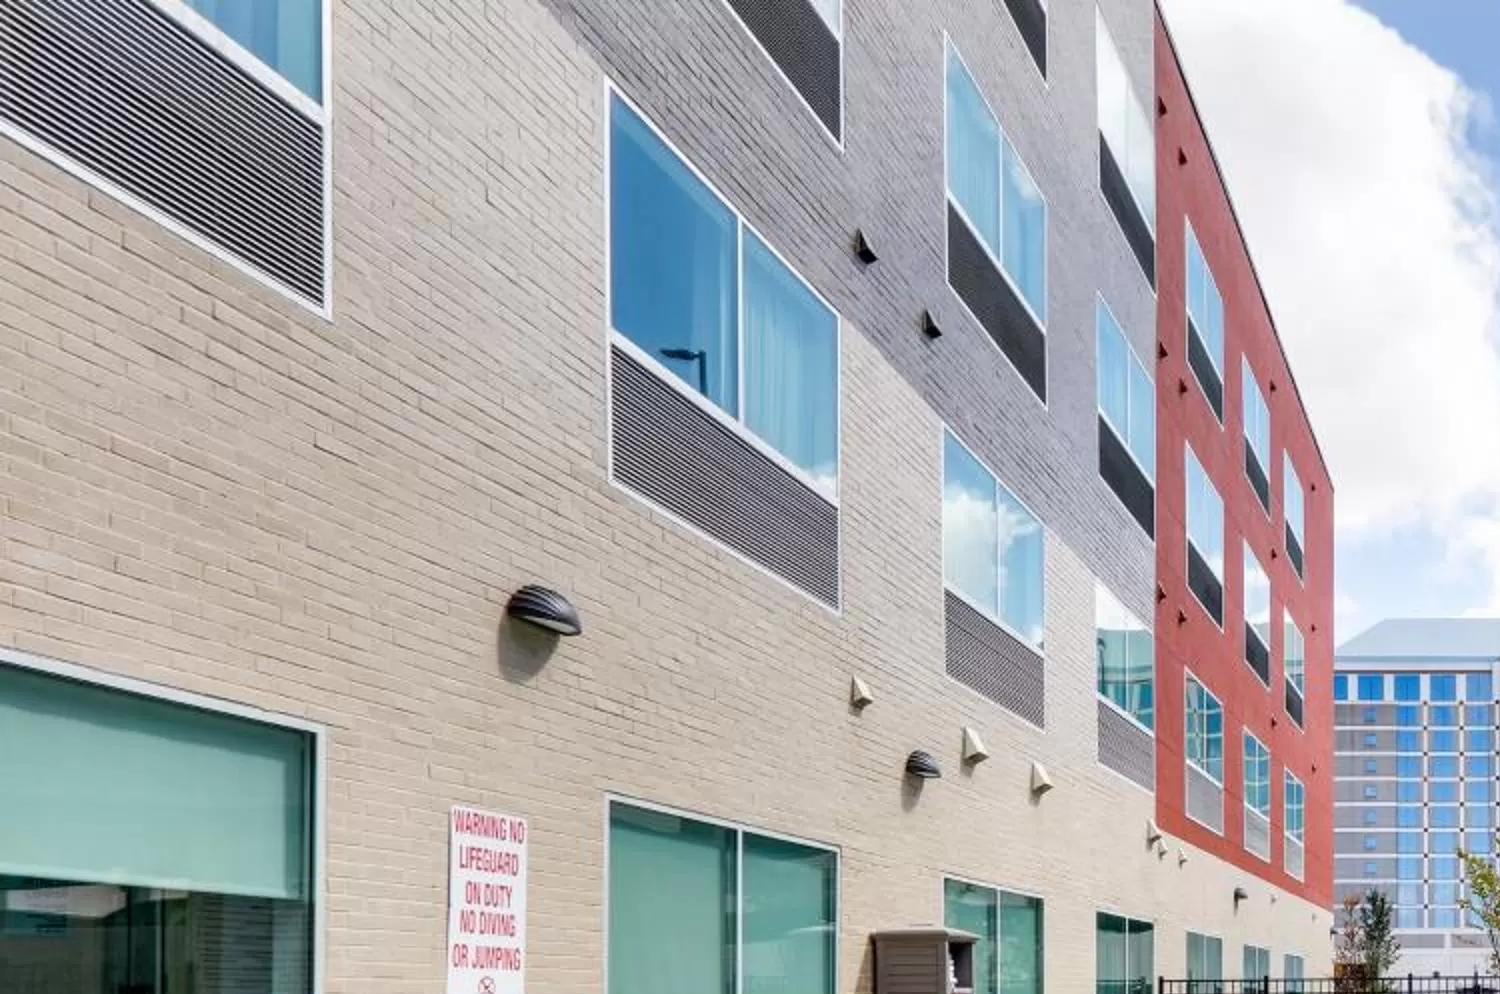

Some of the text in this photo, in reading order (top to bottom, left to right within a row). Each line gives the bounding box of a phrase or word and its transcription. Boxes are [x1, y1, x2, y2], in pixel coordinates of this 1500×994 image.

[454, 809, 525, 845] WARNING NO
[459, 845, 519, 877] LIFEGUARD
[465, 880, 513, 908] ON DUTY
[459, 910, 517, 937] NO DIVING
[452, 943, 521, 971] OR JUMPING
